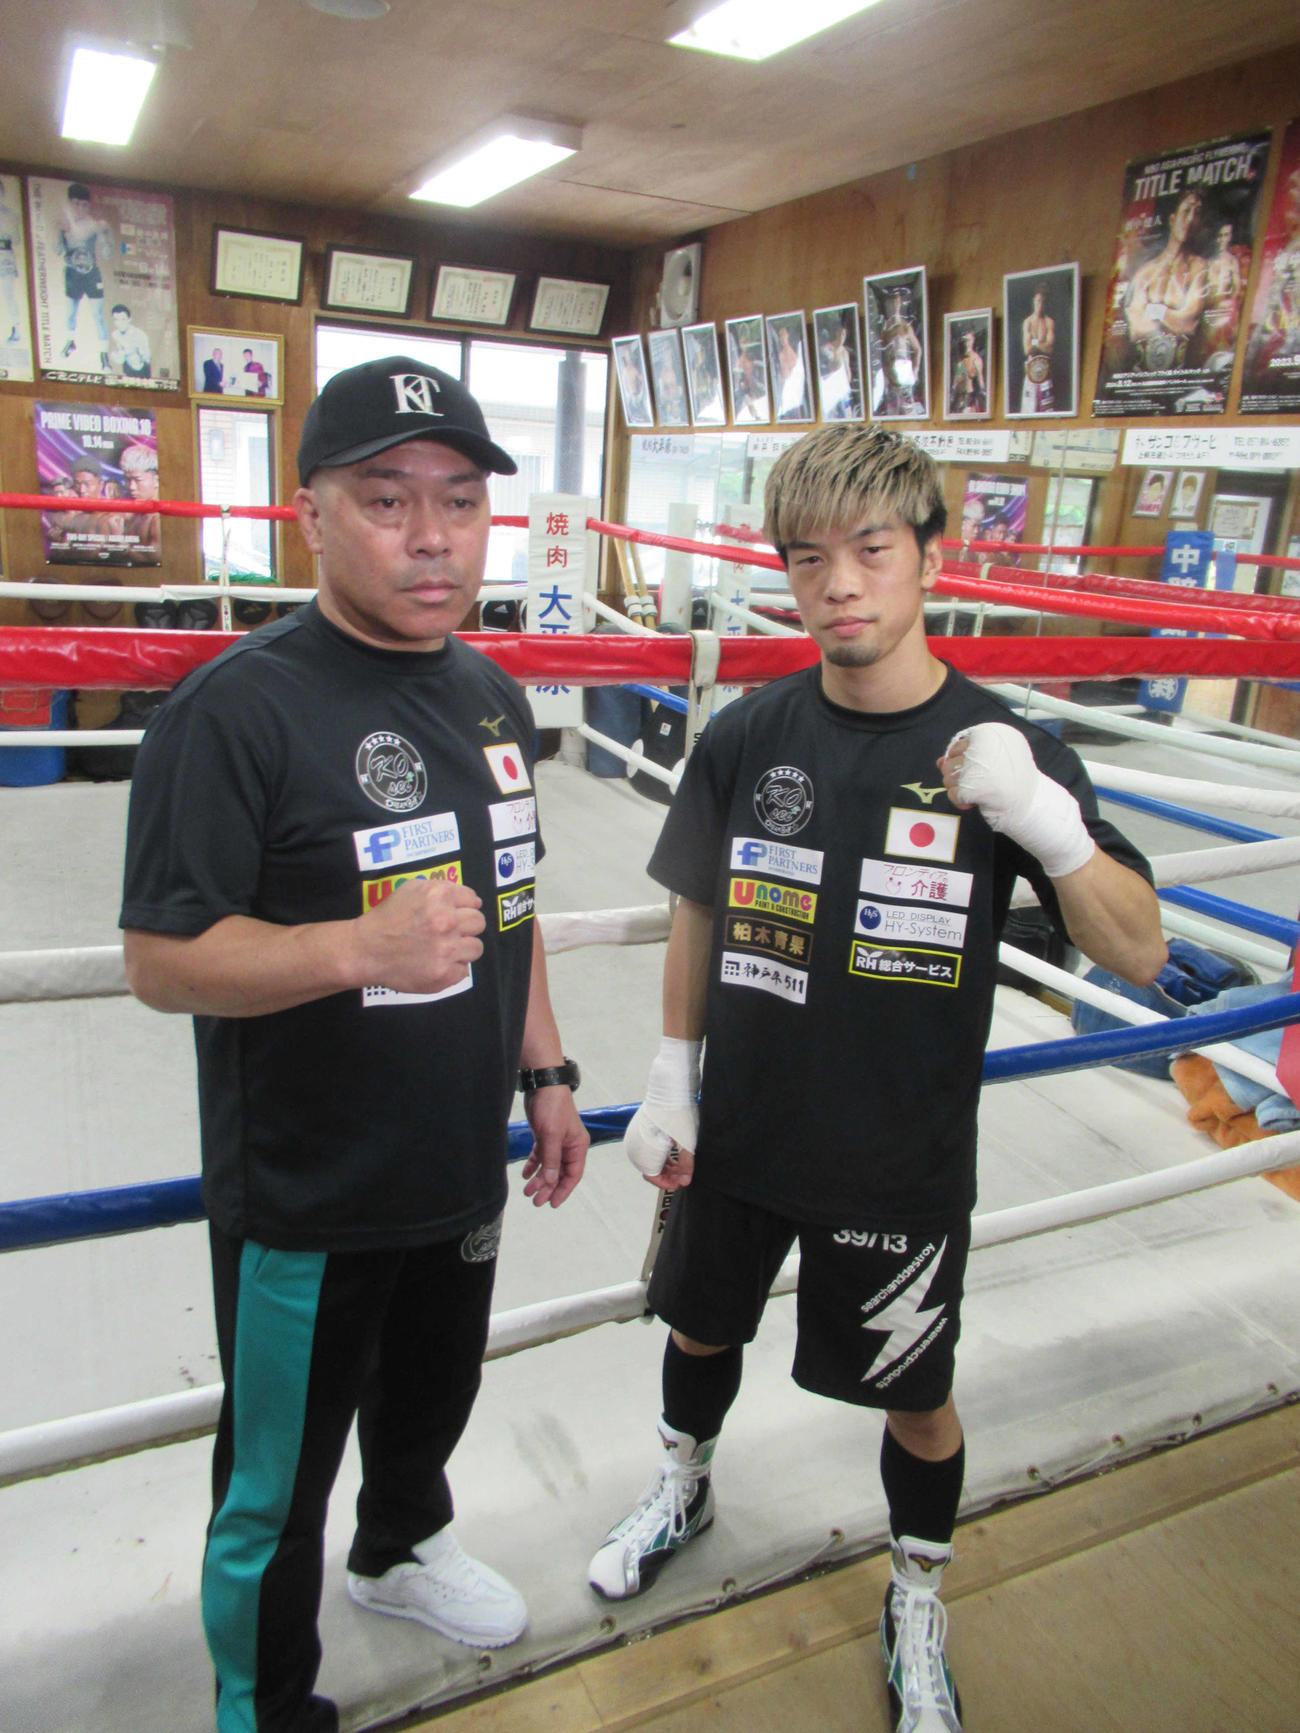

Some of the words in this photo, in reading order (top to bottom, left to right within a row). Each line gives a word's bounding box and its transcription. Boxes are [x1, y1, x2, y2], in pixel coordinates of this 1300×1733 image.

[1135, 169, 1182, 201] TITLE
[1187, 150, 1254, 186] MATCH
[40, 411, 72, 430] PRIME
[72, 413, 102, 432] VIDEO
[401, 820, 433, 839] FIRST
[404, 828, 455, 851] PARTNERS
[768, 844, 797, 860] FIRST
[768, 855, 818, 875] PARTNERS
[911, 879, 949, 901] 介護
[886, 910, 906, 920] LED
[910, 912, 951, 925] DISPLAY
[732, 921, 806, 956] 柏木青果
[884, 919, 962, 941] HY-System
[832, 1229, 908, 1254] 39/13
[860, 1242, 936, 1313] searchanddestroy
